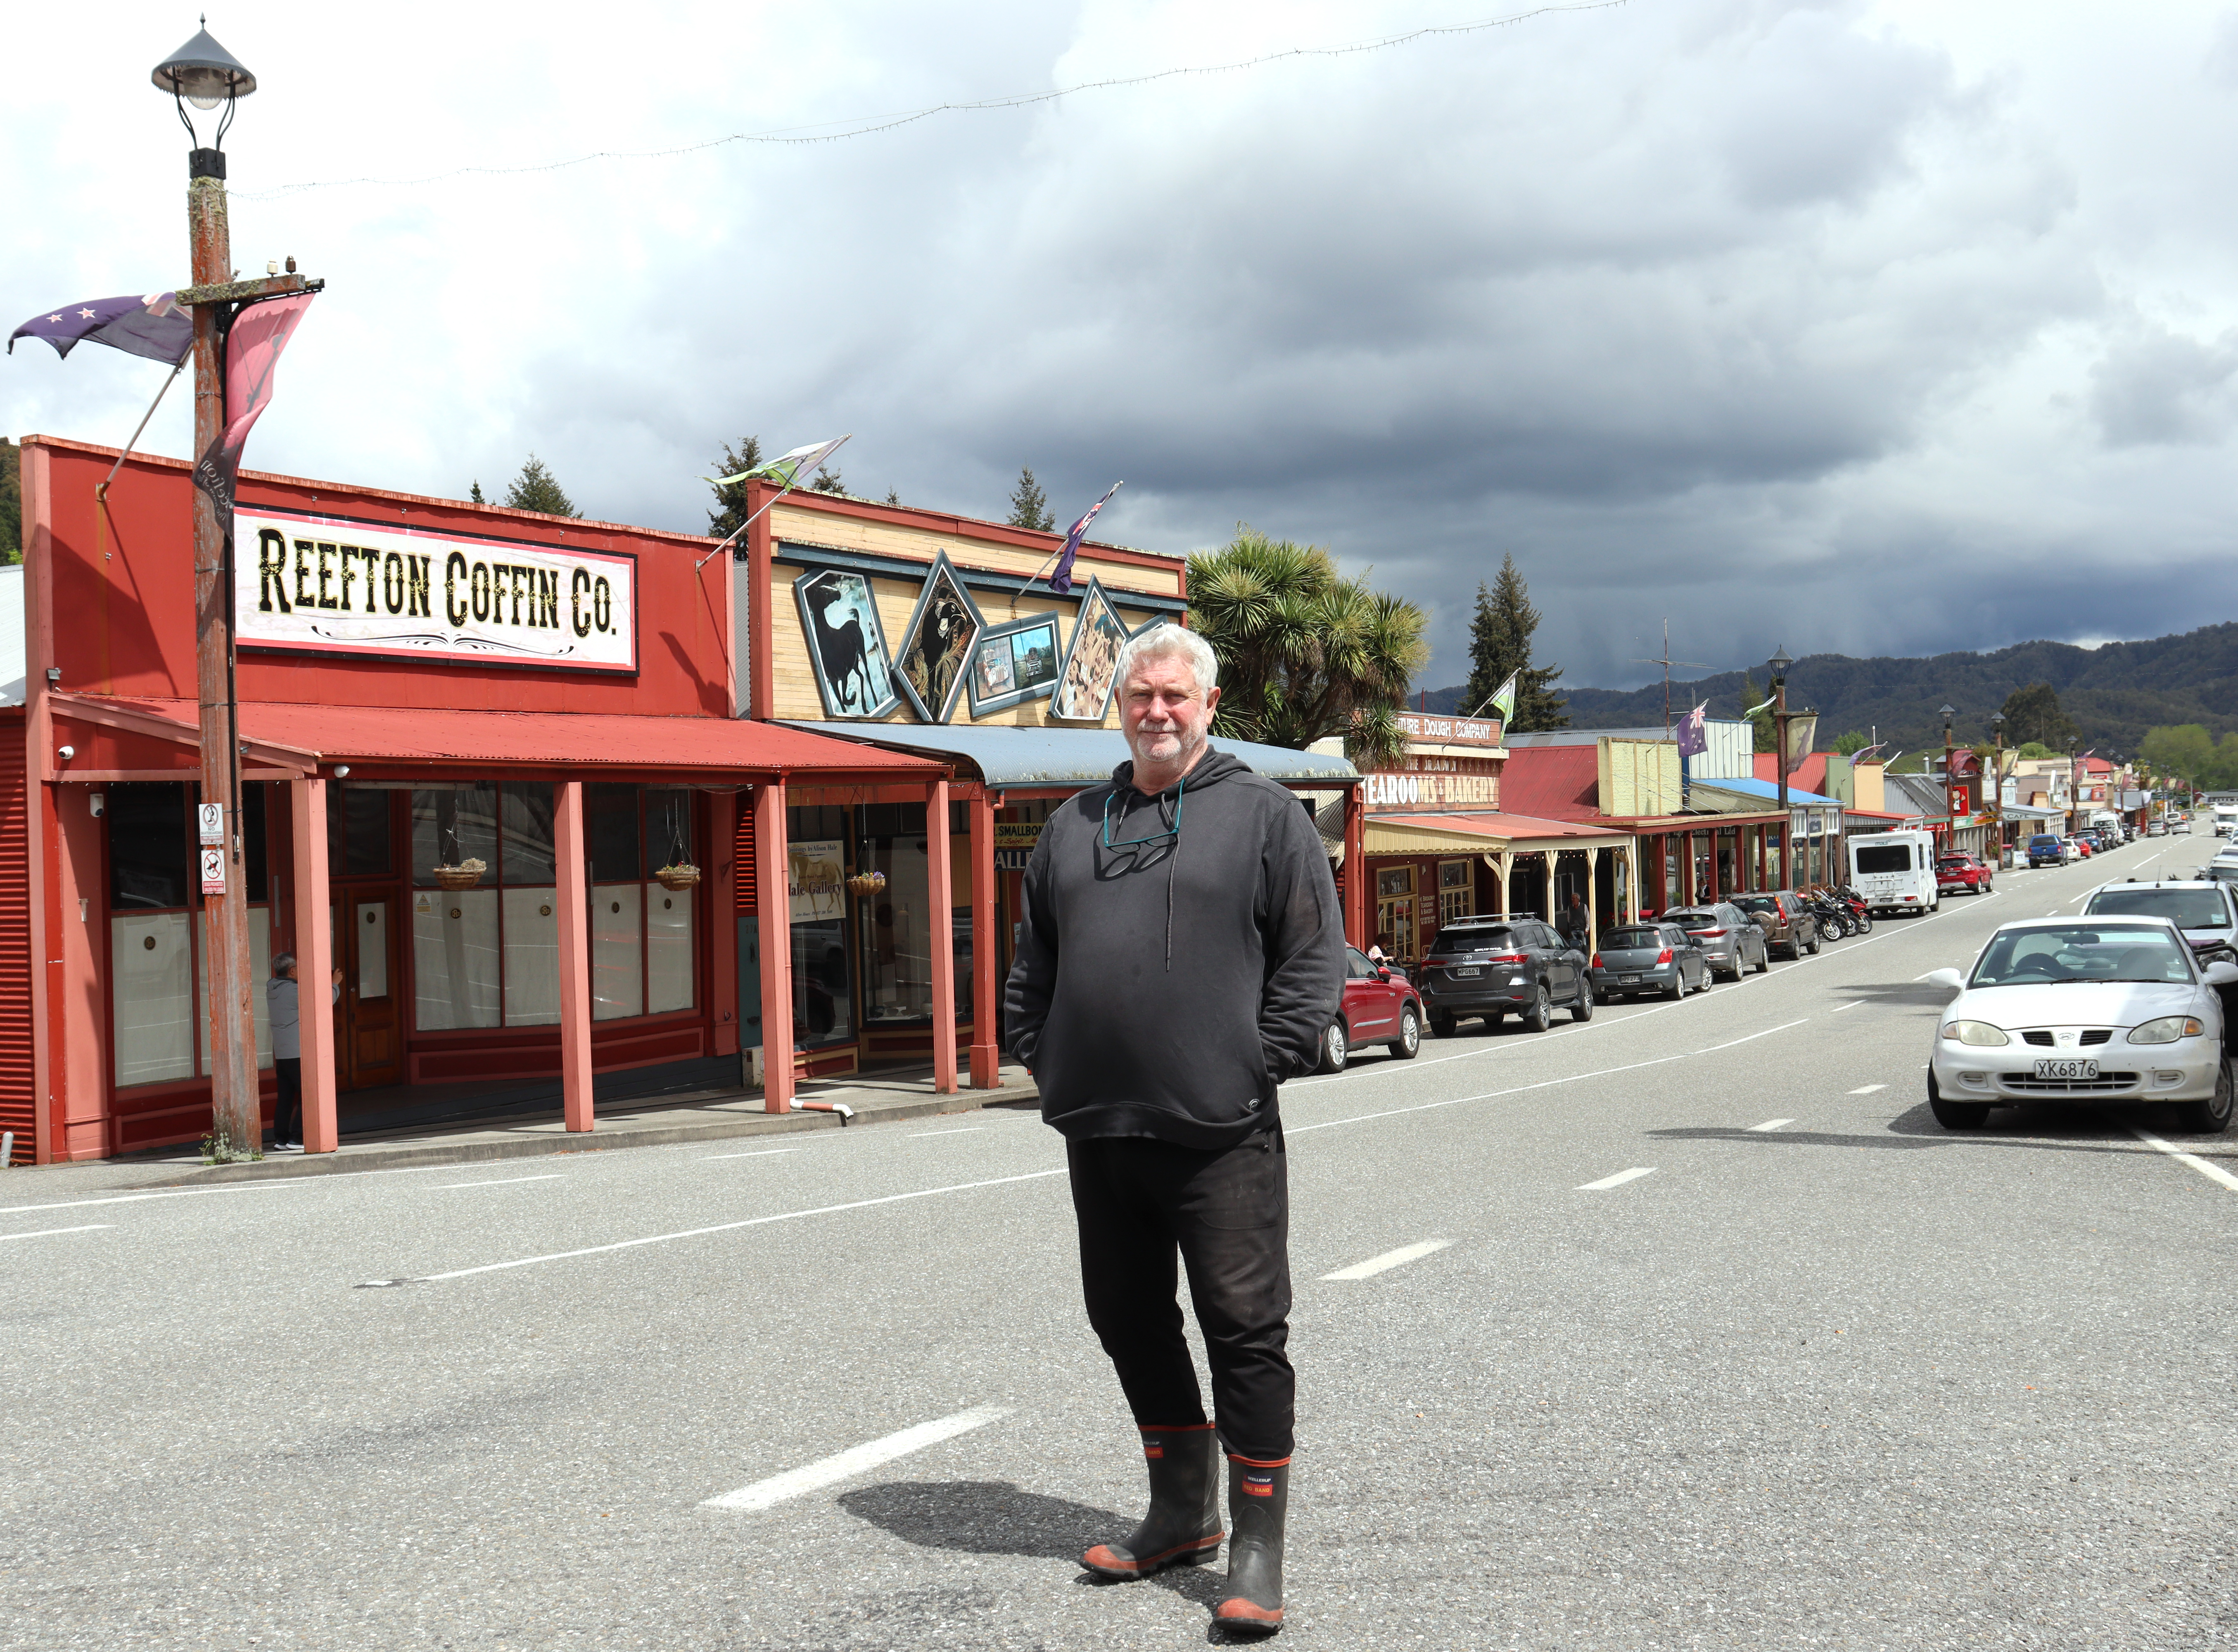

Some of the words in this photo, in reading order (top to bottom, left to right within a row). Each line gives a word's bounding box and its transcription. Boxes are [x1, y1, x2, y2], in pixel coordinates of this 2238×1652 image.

[259, 529, 431, 617] REEFTON
[445, 551, 559, 628] COFFIN
[572, 566, 616, 638] CO.
[1424, 719, 1451, 737] DOUGH
[1455, 721, 1490, 739] COMPANY
[1359, 775, 1437, 804] TEAROOMS
[1439, 783, 1443, 795] &
[1445, 776, 1496, 803] BAKERY
[809, 880, 842, 896] Gallery
[2038, 1062, 2096, 1077] XK6876
